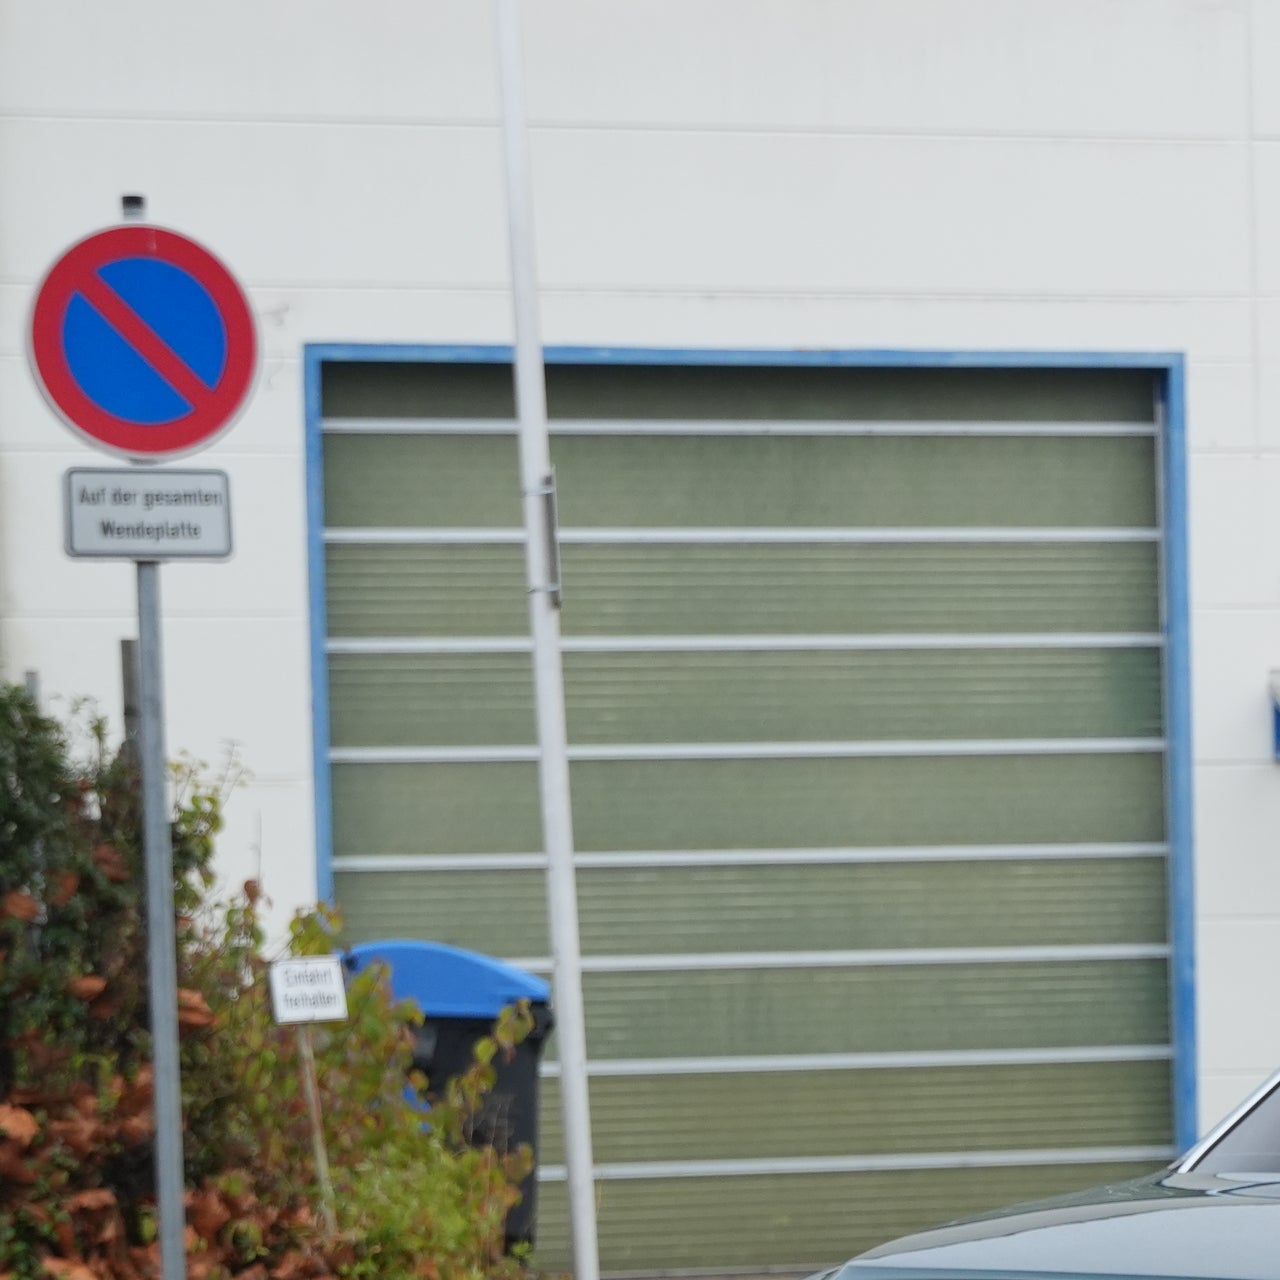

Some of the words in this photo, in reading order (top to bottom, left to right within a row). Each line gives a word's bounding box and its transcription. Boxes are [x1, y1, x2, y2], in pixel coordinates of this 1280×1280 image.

[79, 486, 106, 504] Auf
[112, 488, 139, 505] der
[144, 490, 223, 511] gesamten
[101, 520, 201, 541] Wendeplatte
